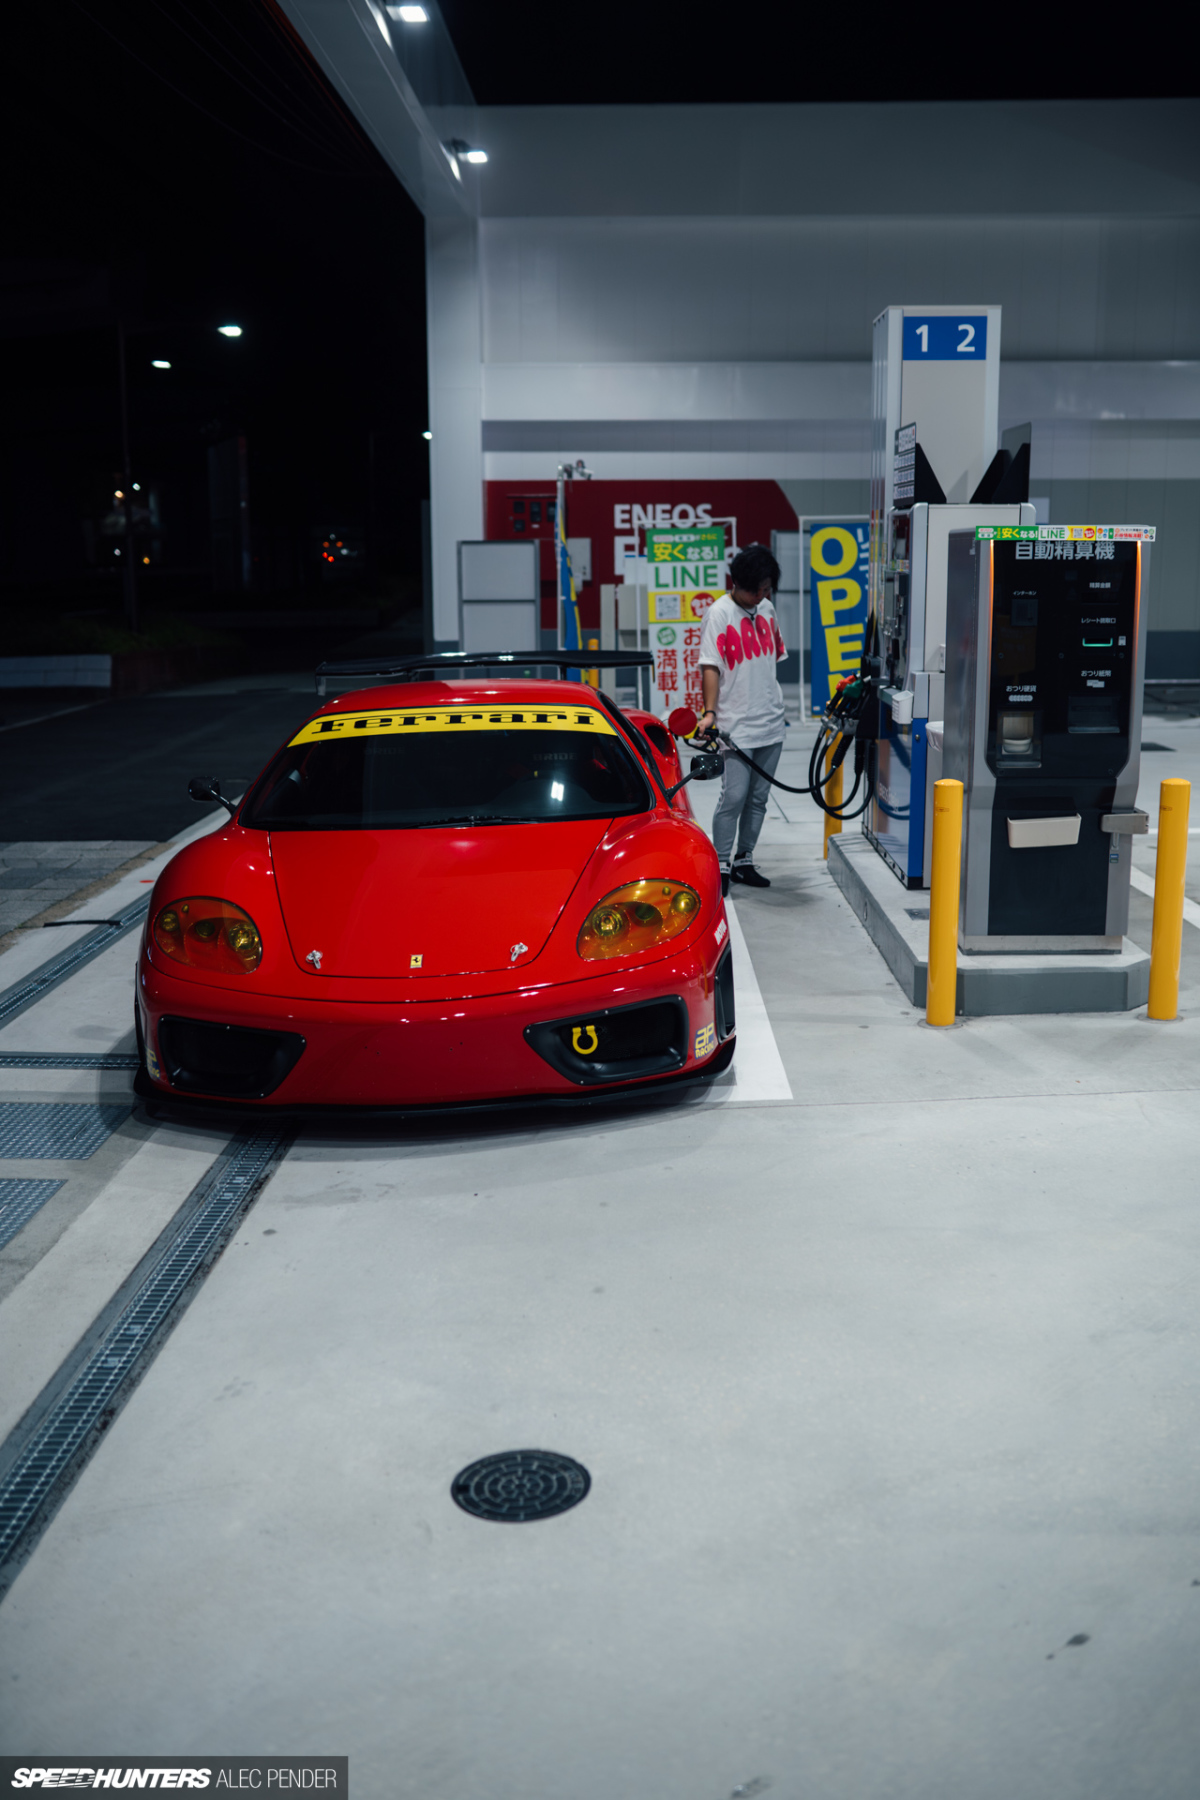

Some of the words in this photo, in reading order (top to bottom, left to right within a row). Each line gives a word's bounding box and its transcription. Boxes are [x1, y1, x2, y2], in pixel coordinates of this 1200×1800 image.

[915, 324, 929, 353] 1
[956, 324, 976, 353] 2
[613, 503, 713, 529] ENEOS
[1040, 530, 1066, 539] LINE
[1015, 541, 1116, 560] 自動精算機
[654, 564, 718, 588] LINE
[311, 710, 596, 735] Ferrari
[533, 752, 578, 761] BRIDE
